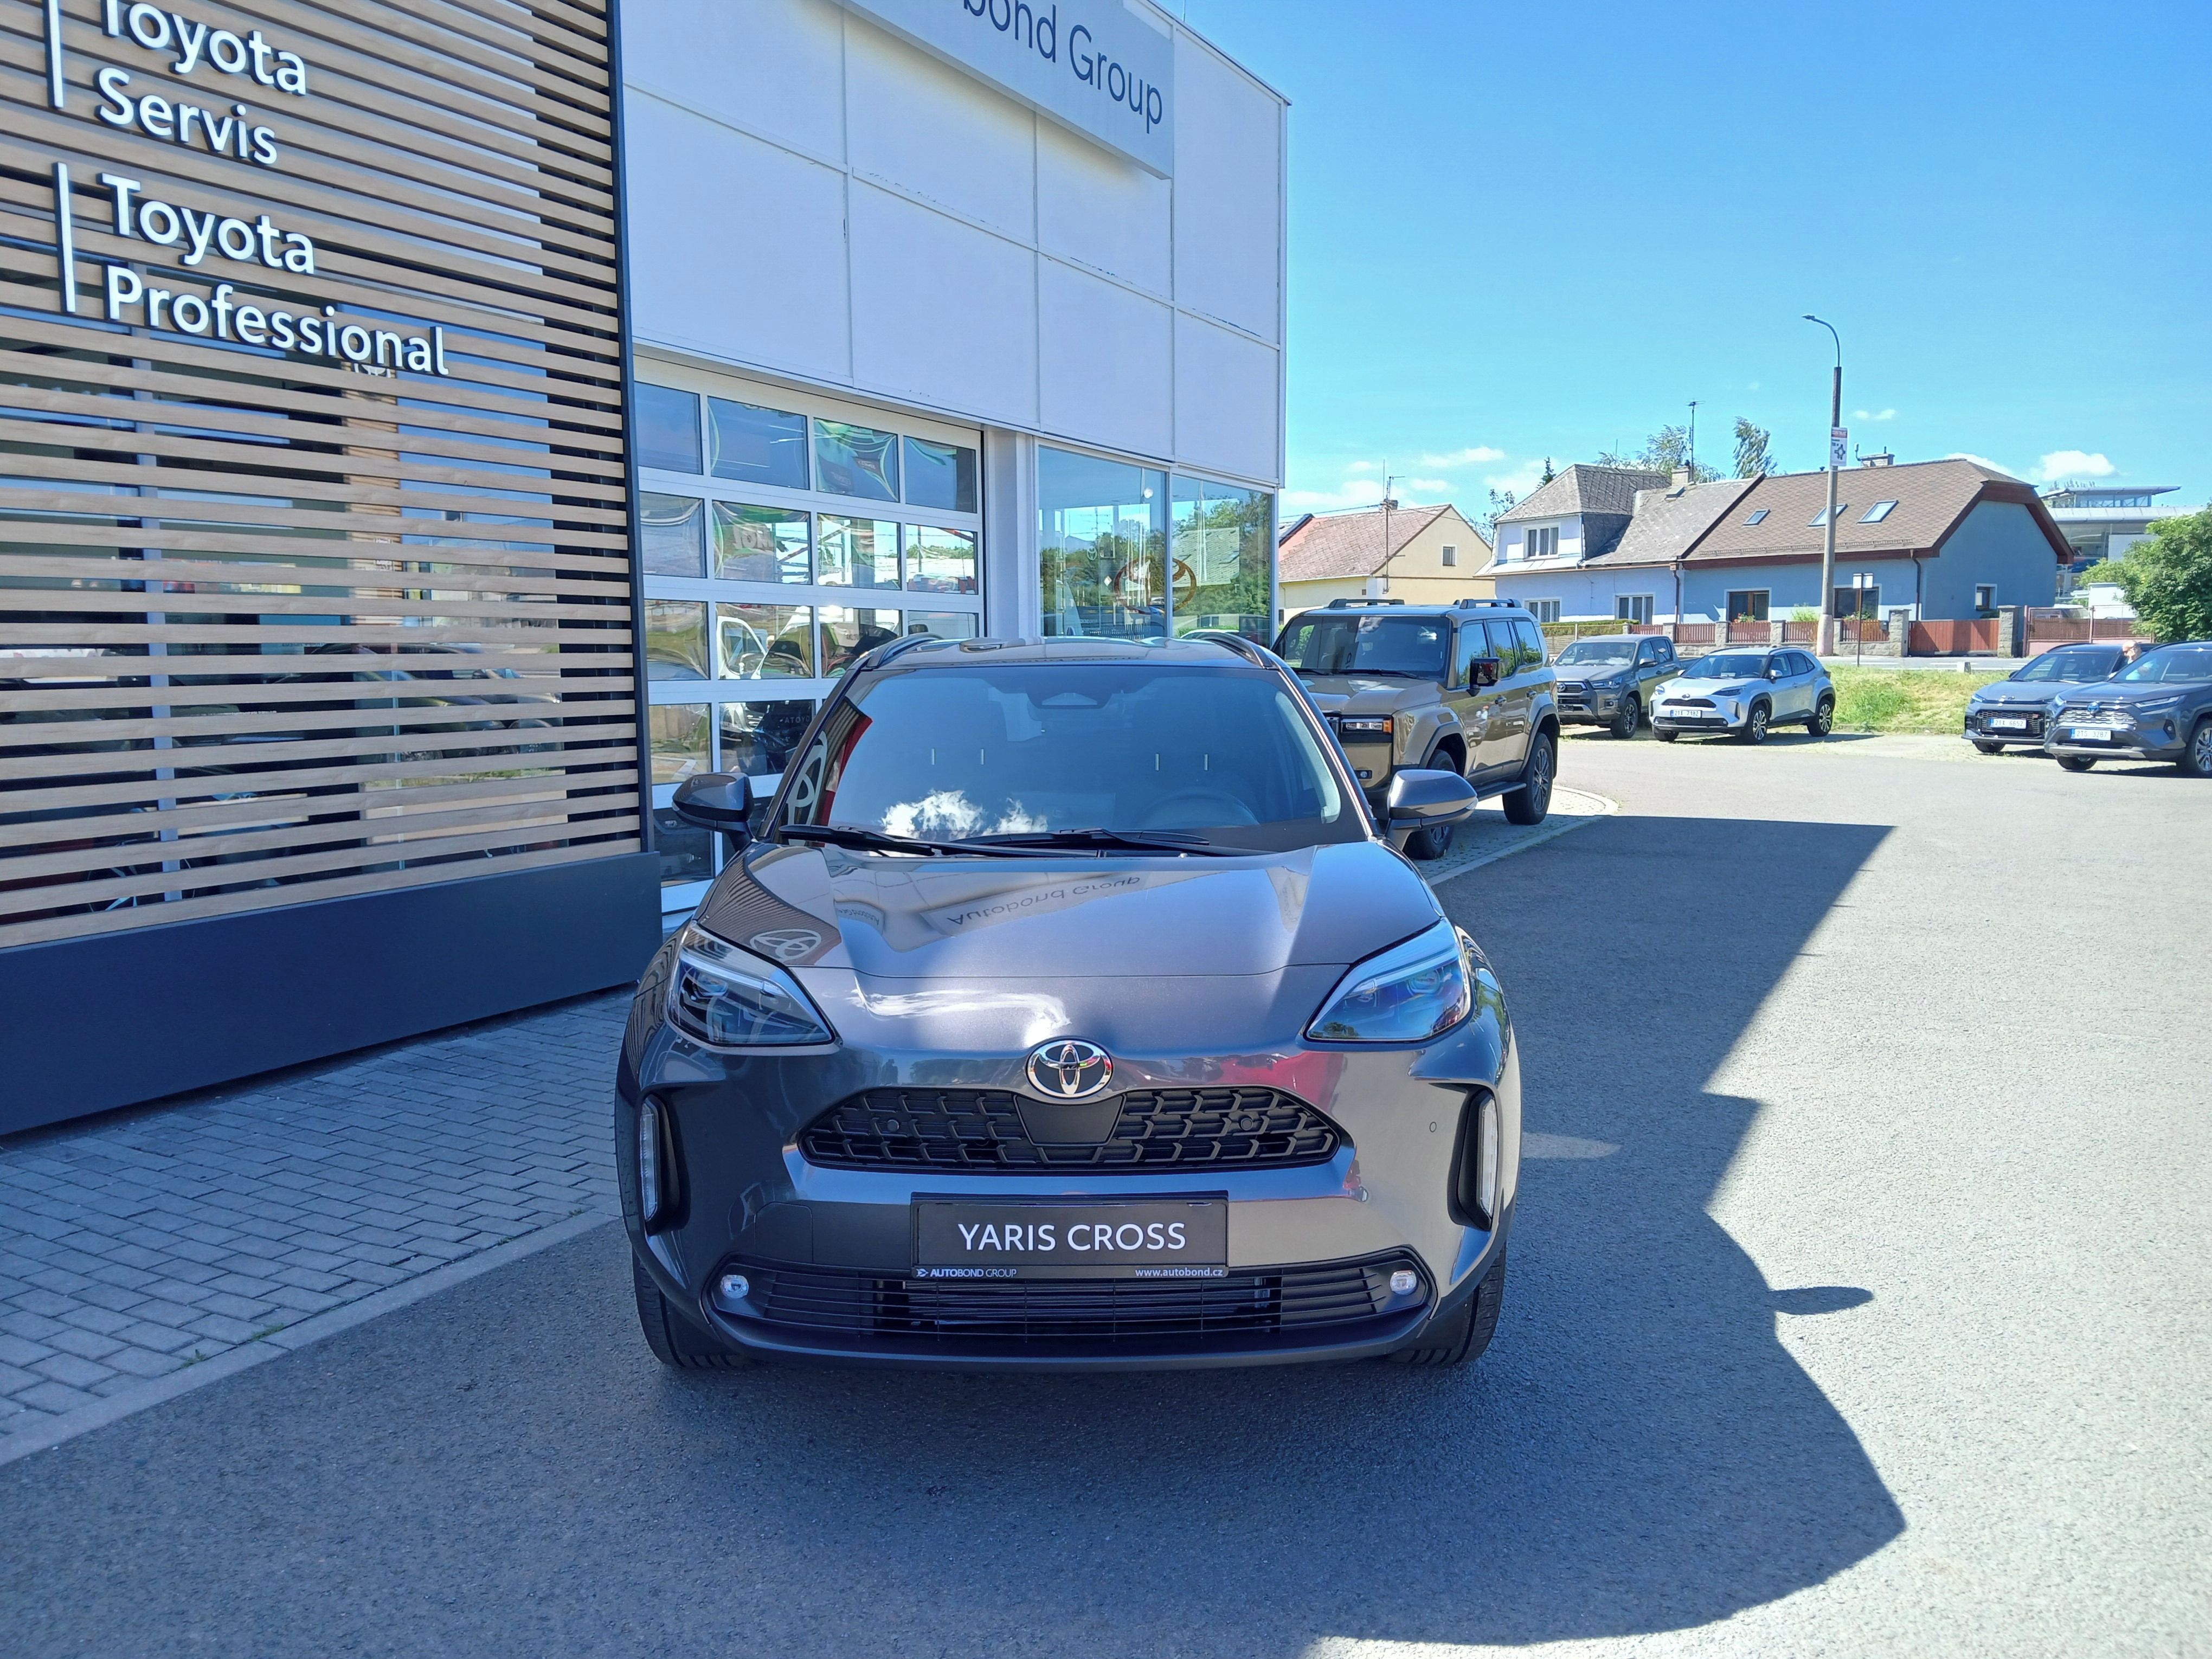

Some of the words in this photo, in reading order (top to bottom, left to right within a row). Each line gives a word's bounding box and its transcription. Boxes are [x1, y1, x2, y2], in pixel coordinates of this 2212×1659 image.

[98, 68, 278, 165] Servis
[963, 0, 1057, 63] ond
[1069, 24, 1163, 134] Group
[102, 173, 314, 274] Toyota
[107, 266, 449, 376] Professional
[930, 1268, 984, 1277] AUTOBOND
[985, 1269, 1017, 1278] GROUP
[1135, 1266, 1223, 1277] www.autobond.cz
[957, 1223, 1056, 1251] YARIS
[1068, 1223, 1186, 1251] CROSS
